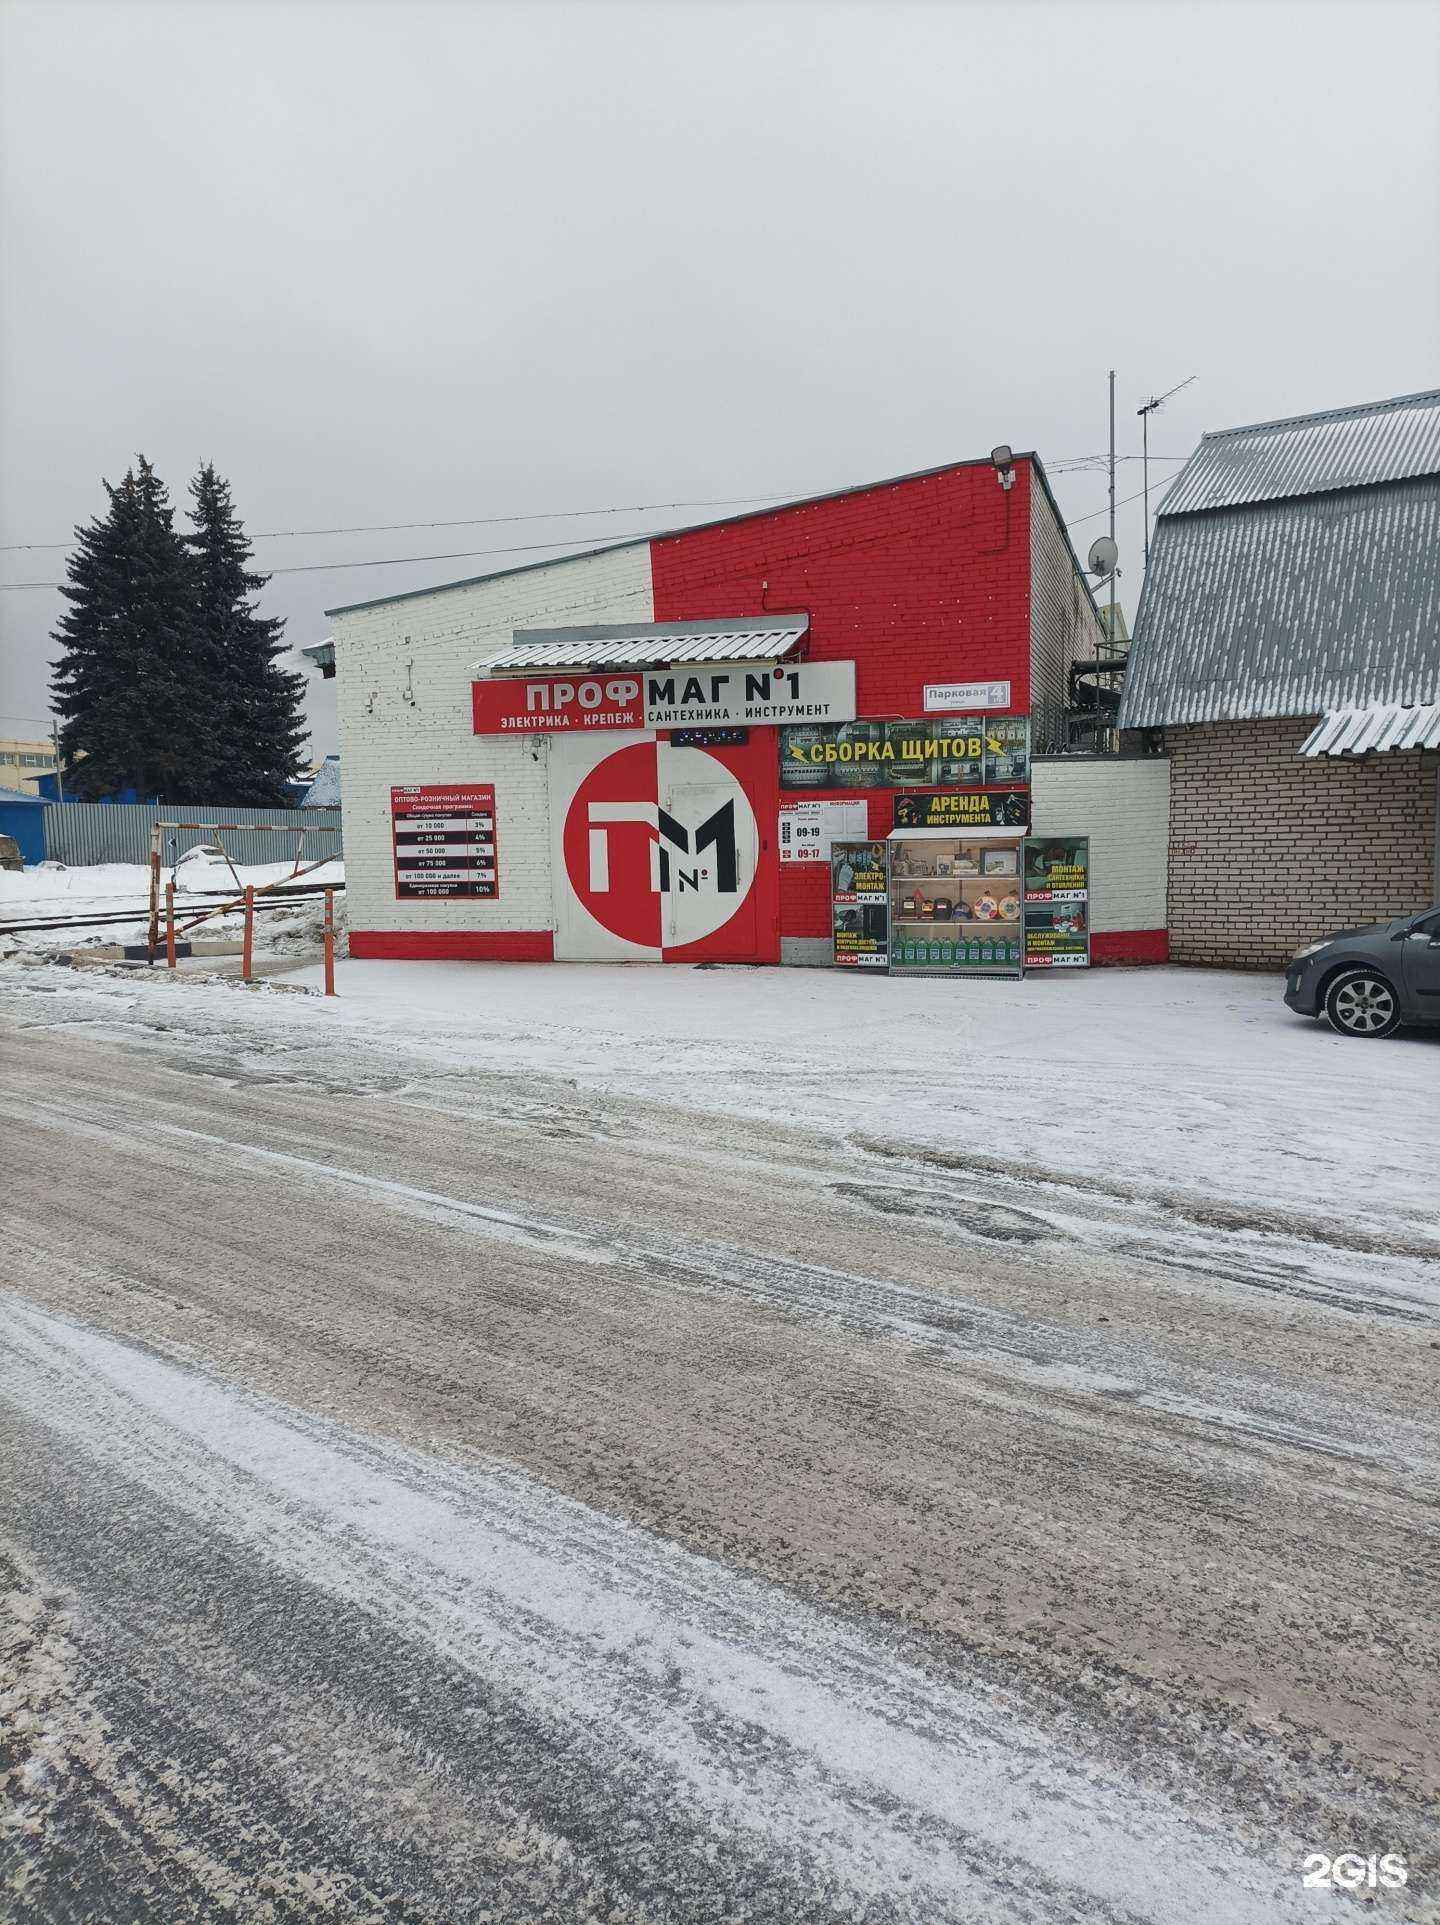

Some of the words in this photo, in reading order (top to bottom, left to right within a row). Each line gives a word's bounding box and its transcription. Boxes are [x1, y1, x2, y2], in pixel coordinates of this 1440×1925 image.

[526, 680, 639, 711] ПРОФ
[648, 675, 730, 706] МАГ
[929, 690, 986, 699] Парковая
[501, 715, 569, 729] ЭЛЕКТРИКА
[583, 712, 634, 726] КРЕПЕЖ
[648, 707, 730, 722] САНТЕХНИКА
[745, 703, 830, 719] ИНСТРУМЕНТ
[810, 741, 896, 762] СБОРКА
[902, 738, 982, 761] ЩИТОВ
[395, 794, 460, 803] ОПТОВО-РОЗНИЧНЫЙ
[931, 796, 990, 812] АРЕНДА
[927, 813, 991, 825] ИНСТРУМЕНТА
[797, 827, 820, 837] 09-19
[798, 849, 820, 858] 09-17
